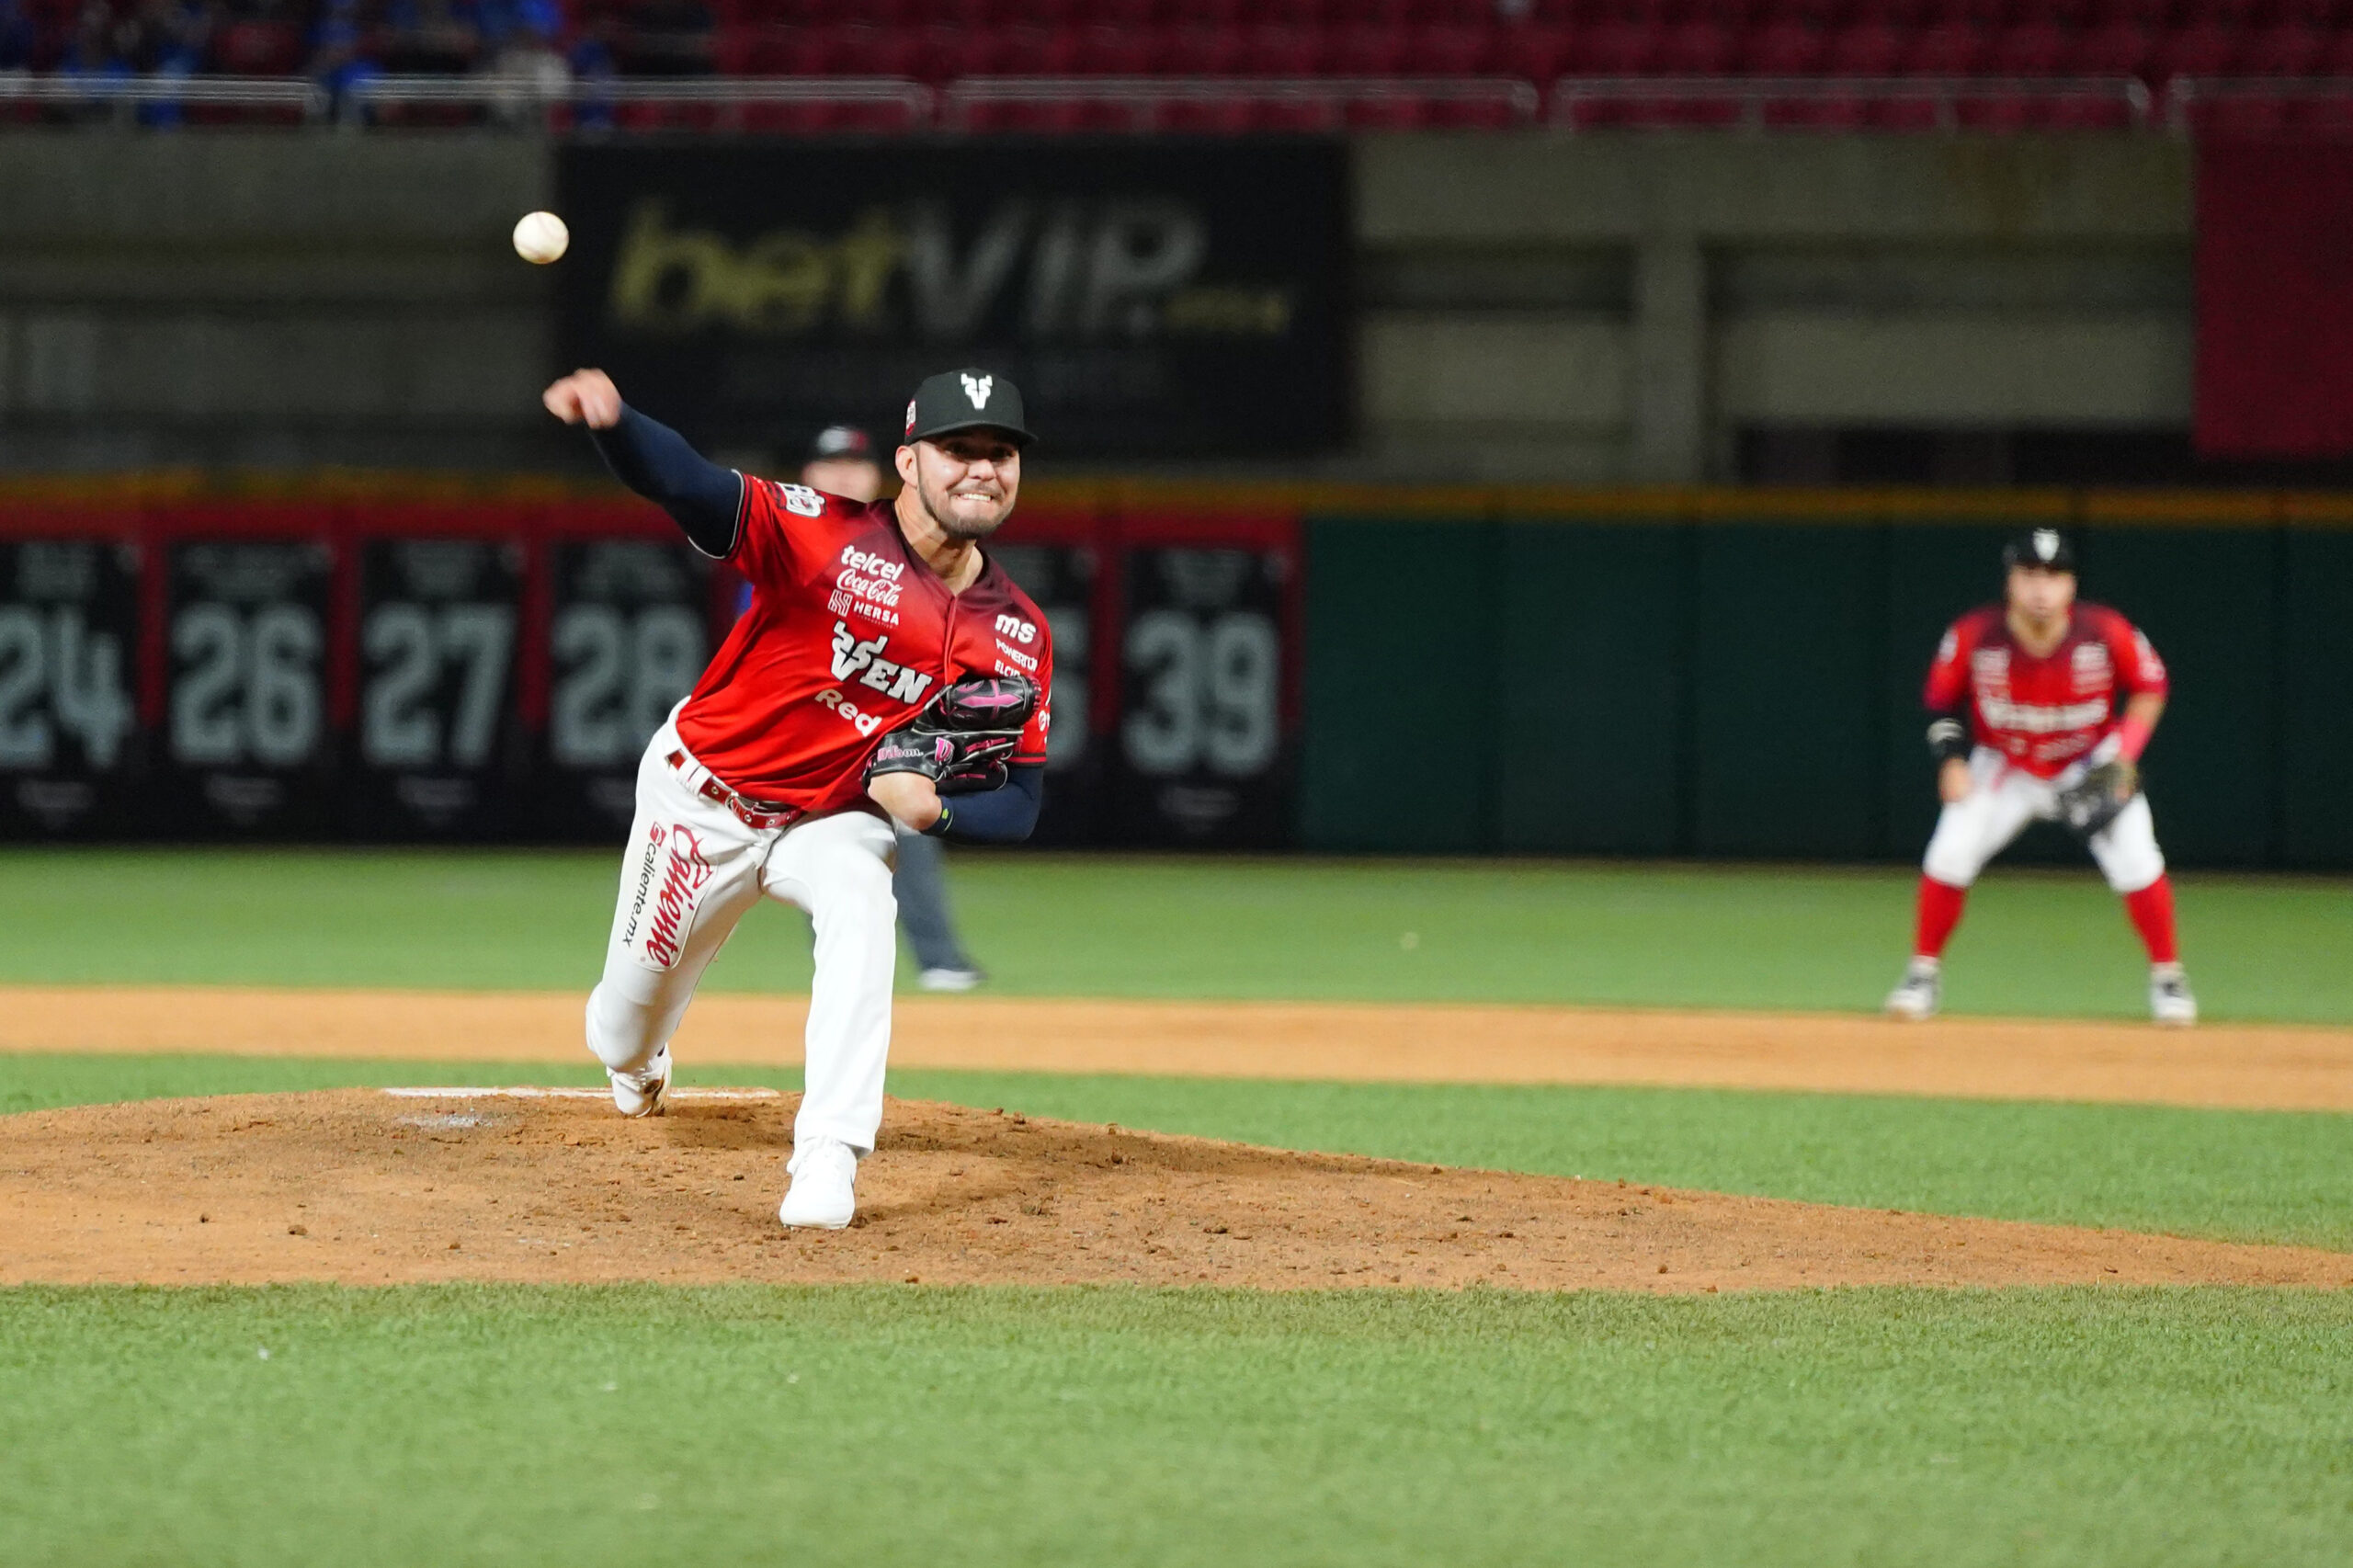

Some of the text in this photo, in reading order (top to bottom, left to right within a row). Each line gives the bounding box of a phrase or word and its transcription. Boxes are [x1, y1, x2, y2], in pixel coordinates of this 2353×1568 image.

[840, 544, 904, 582] telcel
[853, 600, 900, 626] HERSA
[0, 603, 131, 767] 24
[172, 603, 323, 765] 26
[364, 603, 517, 765] 27
[995, 614, 1037, 643] ms
[814, 688, 883, 738] Red
[1123, 610, 1279, 774] 39
[622, 842, 656, 949] caliente.mx
[646, 824, 713, 967] Caliente
